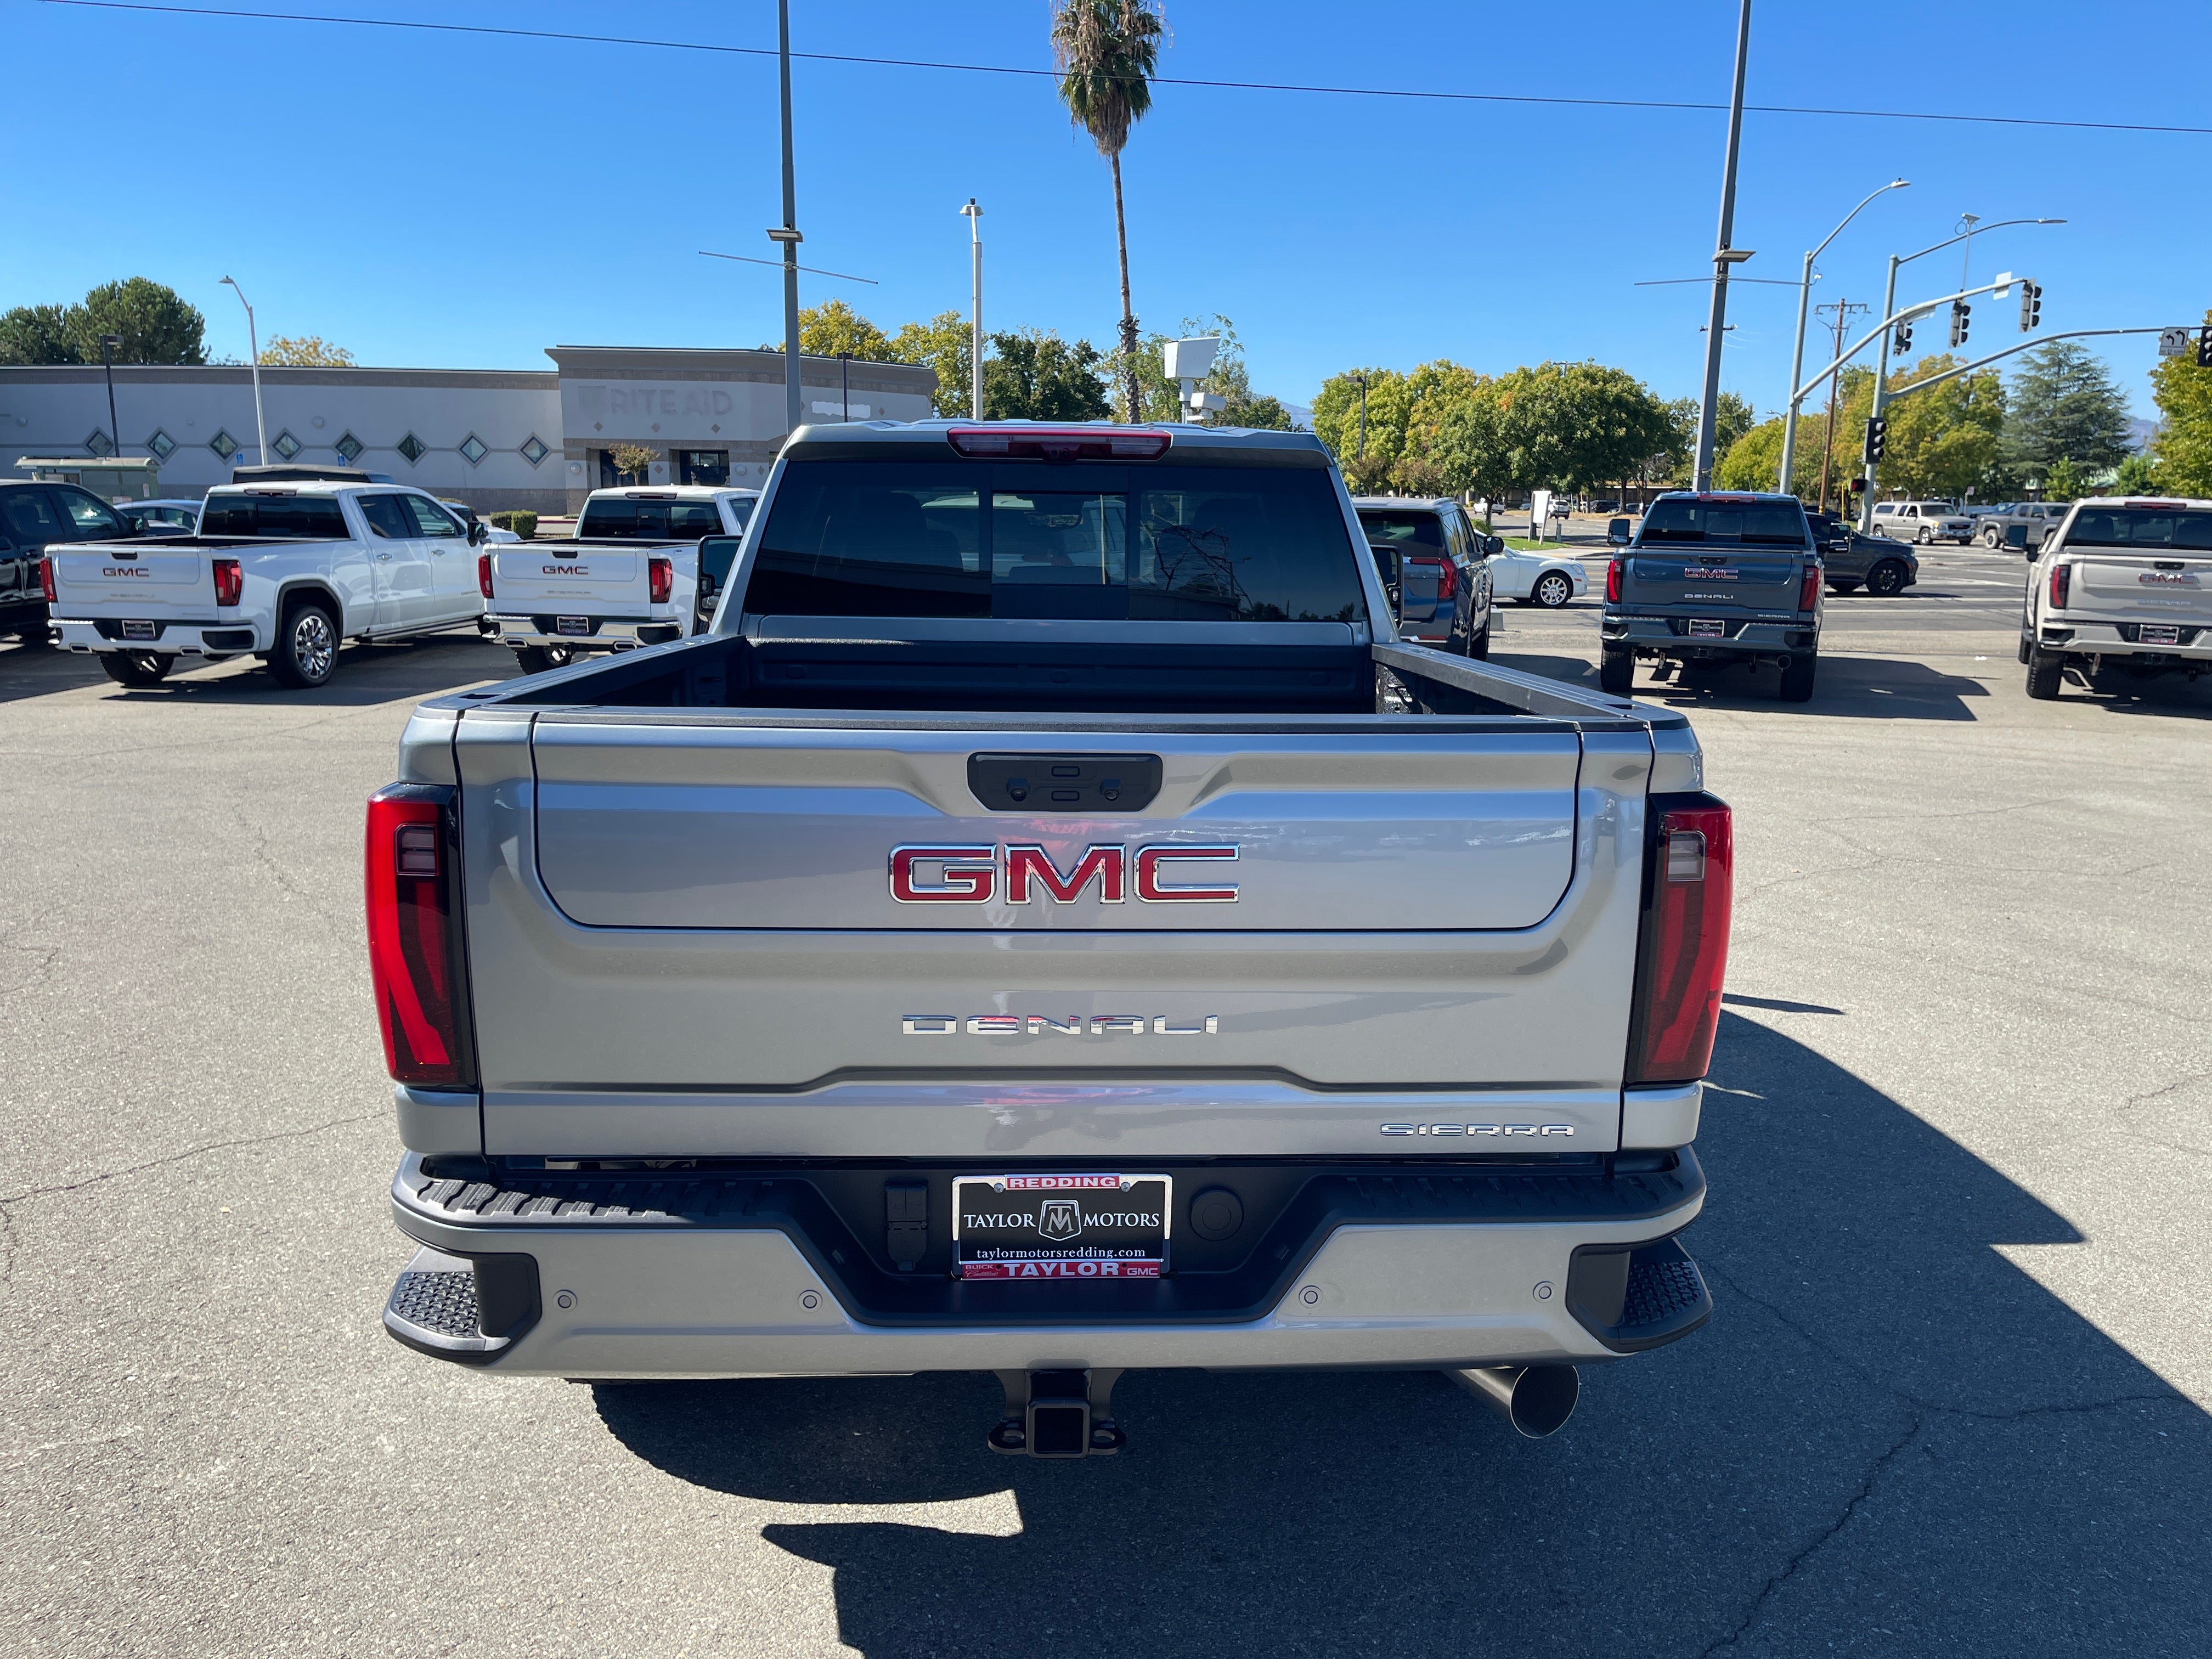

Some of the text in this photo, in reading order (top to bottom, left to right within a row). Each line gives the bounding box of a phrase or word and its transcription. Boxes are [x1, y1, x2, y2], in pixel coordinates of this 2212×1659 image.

[610, 388, 733, 416] RITE AID
[103, 567, 150, 578] GMC
[541, 566, 589, 575] GMC
[1684, 567, 1738, 579] GMC
[2138, 573, 2196, 585] GMC
[889, 843, 1240, 905] GMC
[902, 1015, 1218, 1035] DENALI
[1380, 1124, 1575, 1137] SIERRA
[1009, 1177, 1116, 1188] REDDING
[963, 1214, 1036, 1228] TAYLOR
[1083, 1212, 1159, 1227] MOTORS
[977, 1246, 1146, 1260] taylormotorsredding.com
[965, 1269, 998, 1278] Cadillac
[1003, 1262, 1120, 1277] TAYLOR
[1126, 1267, 1159, 1277] GMC
